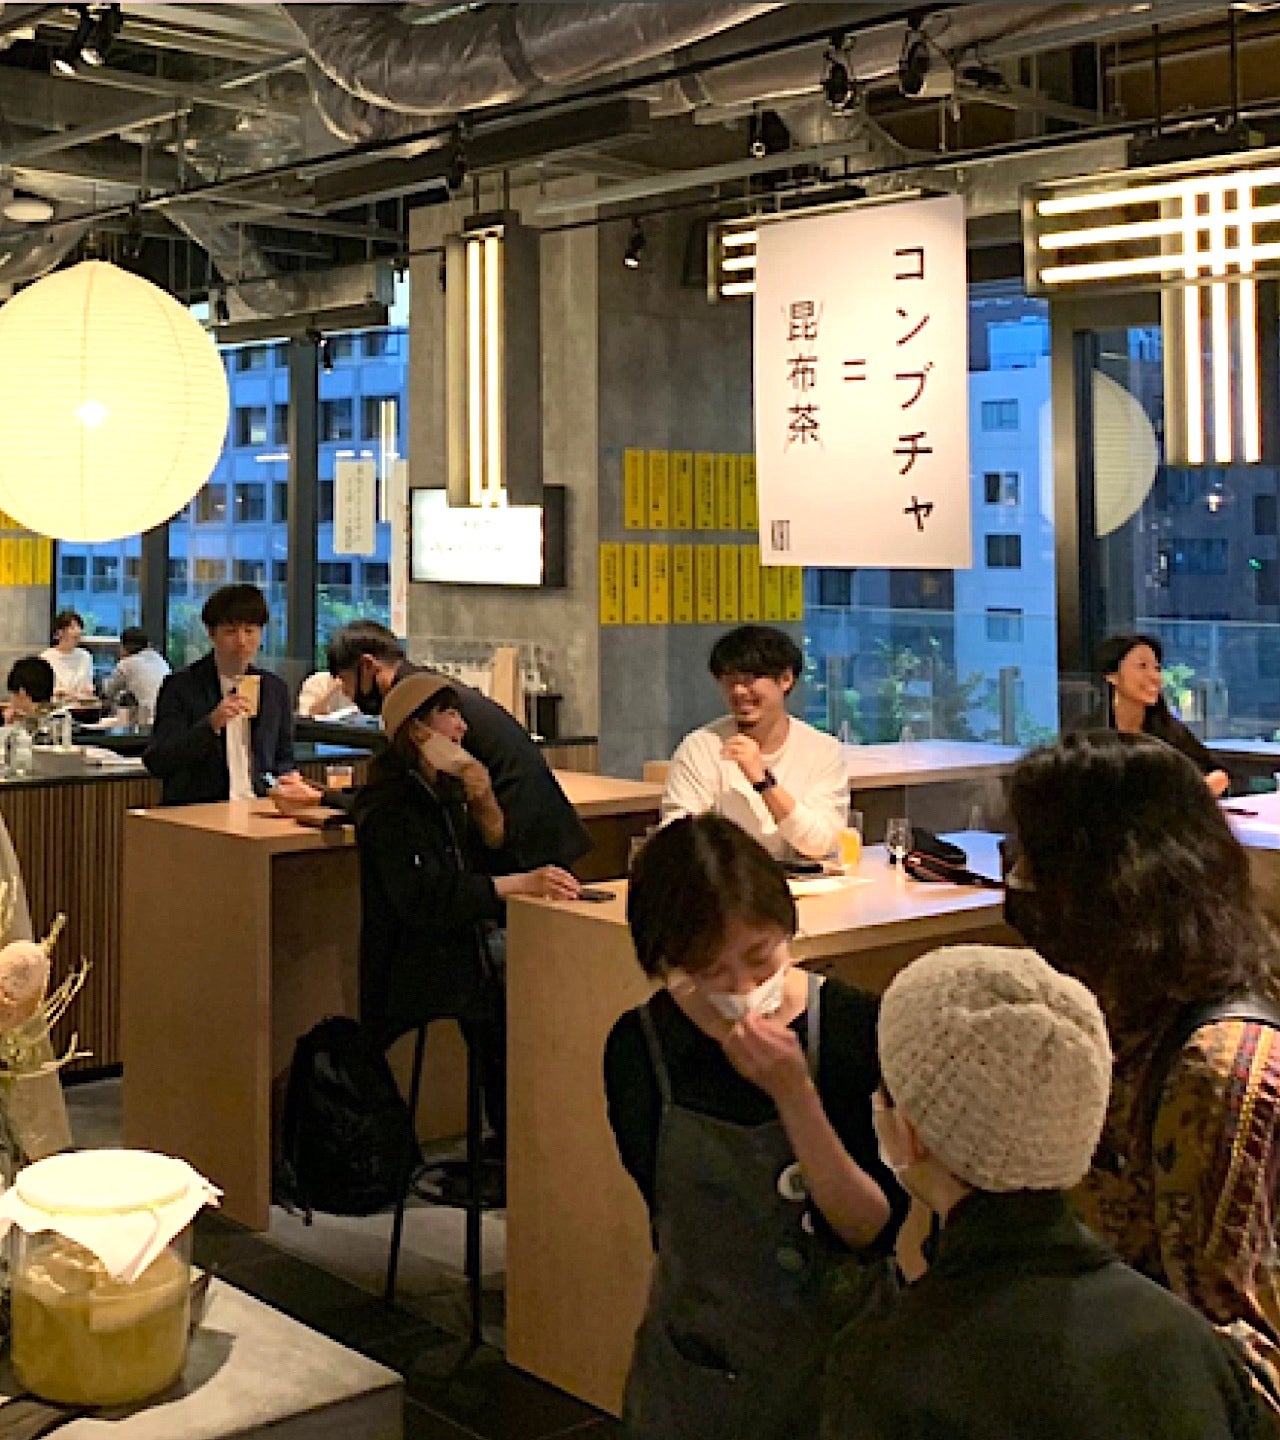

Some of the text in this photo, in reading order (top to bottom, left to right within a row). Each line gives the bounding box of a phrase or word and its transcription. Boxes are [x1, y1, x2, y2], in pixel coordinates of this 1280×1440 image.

[786, 300, 820, 445] 昆布茶
[892, 246, 936, 533] コンブチャ
